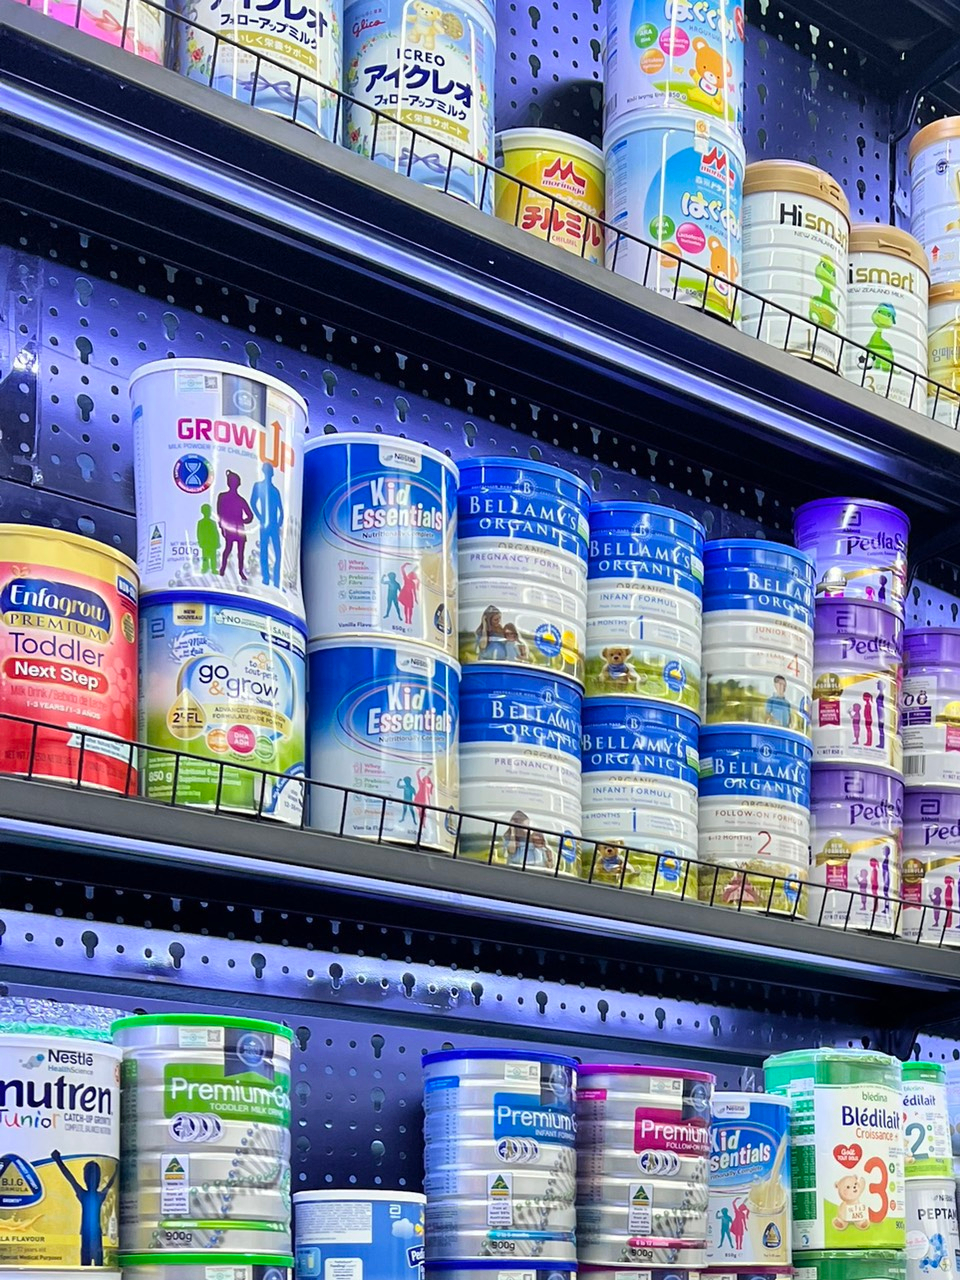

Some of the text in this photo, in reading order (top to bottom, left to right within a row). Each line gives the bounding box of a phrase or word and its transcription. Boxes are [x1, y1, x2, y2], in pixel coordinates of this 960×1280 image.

[396, 47, 446, 66] ICREO
[363, 64, 475, 109] アイクレオ
[374, 94, 468, 120] フォローアップミルク
[541, 179, 586, 196] morinaga
[779, 202, 802, 226] Hi
[856, 264, 915, 294] smart
[178, 418, 256, 449] GROW
[370, 477, 410, 506] Kid
[352, 503, 443, 531] Essentials
[469, 496, 578, 532] BELLAMY'S
[470, 553, 530, 565] PREGNANCY
[590, 540, 690, 571] BELLAMY'S
[10, 584, 106, 622] Enfagrow
[600, 593, 635, 601] INFANT
[9, 614, 102, 641] PREMIUM
[227, 615, 240, 623] NO
[596, 619, 628, 628] MONTHS
[273, 628, 289, 638] SANS
[9, 632, 104, 667] Toddler
[15, 661, 99, 690] Next Step
[787, 653, 800, 678] 4
[199, 664, 278, 699] go & grow
[387, 681, 424, 711] Kid
[368, 706, 452, 736] Essentials
[582, 734, 683, 759] BELLAMY'S
[494, 757, 554, 769] PREGNANCY
[591, 753, 675, 771] ORGANIC
[714, 758, 806, 785] BELLAMY'S
[592, 786, 627, 795] INFANT
[724, 776, 798, 798] ORGANIC
[715, 810, 770, 819] FOLLOW-ON
[757, 831, 772, 856] 2
[48, 1050, 93, 1066] Nestlé
[48, 1065, 93, 1076] HealthScience
[0, 1076, 111, 1115] nutren
[171, 1077, 270, 1105] Premium
[209, 1103, 266, 1114] TODDLER MILK
[497, 1105, 570, 1129] Premium
[842, 1106, 900, 1129] Blédilait
[536, 1128, 555, 1137] INFANT
[641, 1119, 710, 1145] Premium
[856, 1128, 893, 1141] Croissance
[905, 1122, 928, 1160] 2
[864, 1156, 888, 1223] 3
[166, 1231, 192, 1242] 900g
[492, 1239, 516, 1252] 900g
